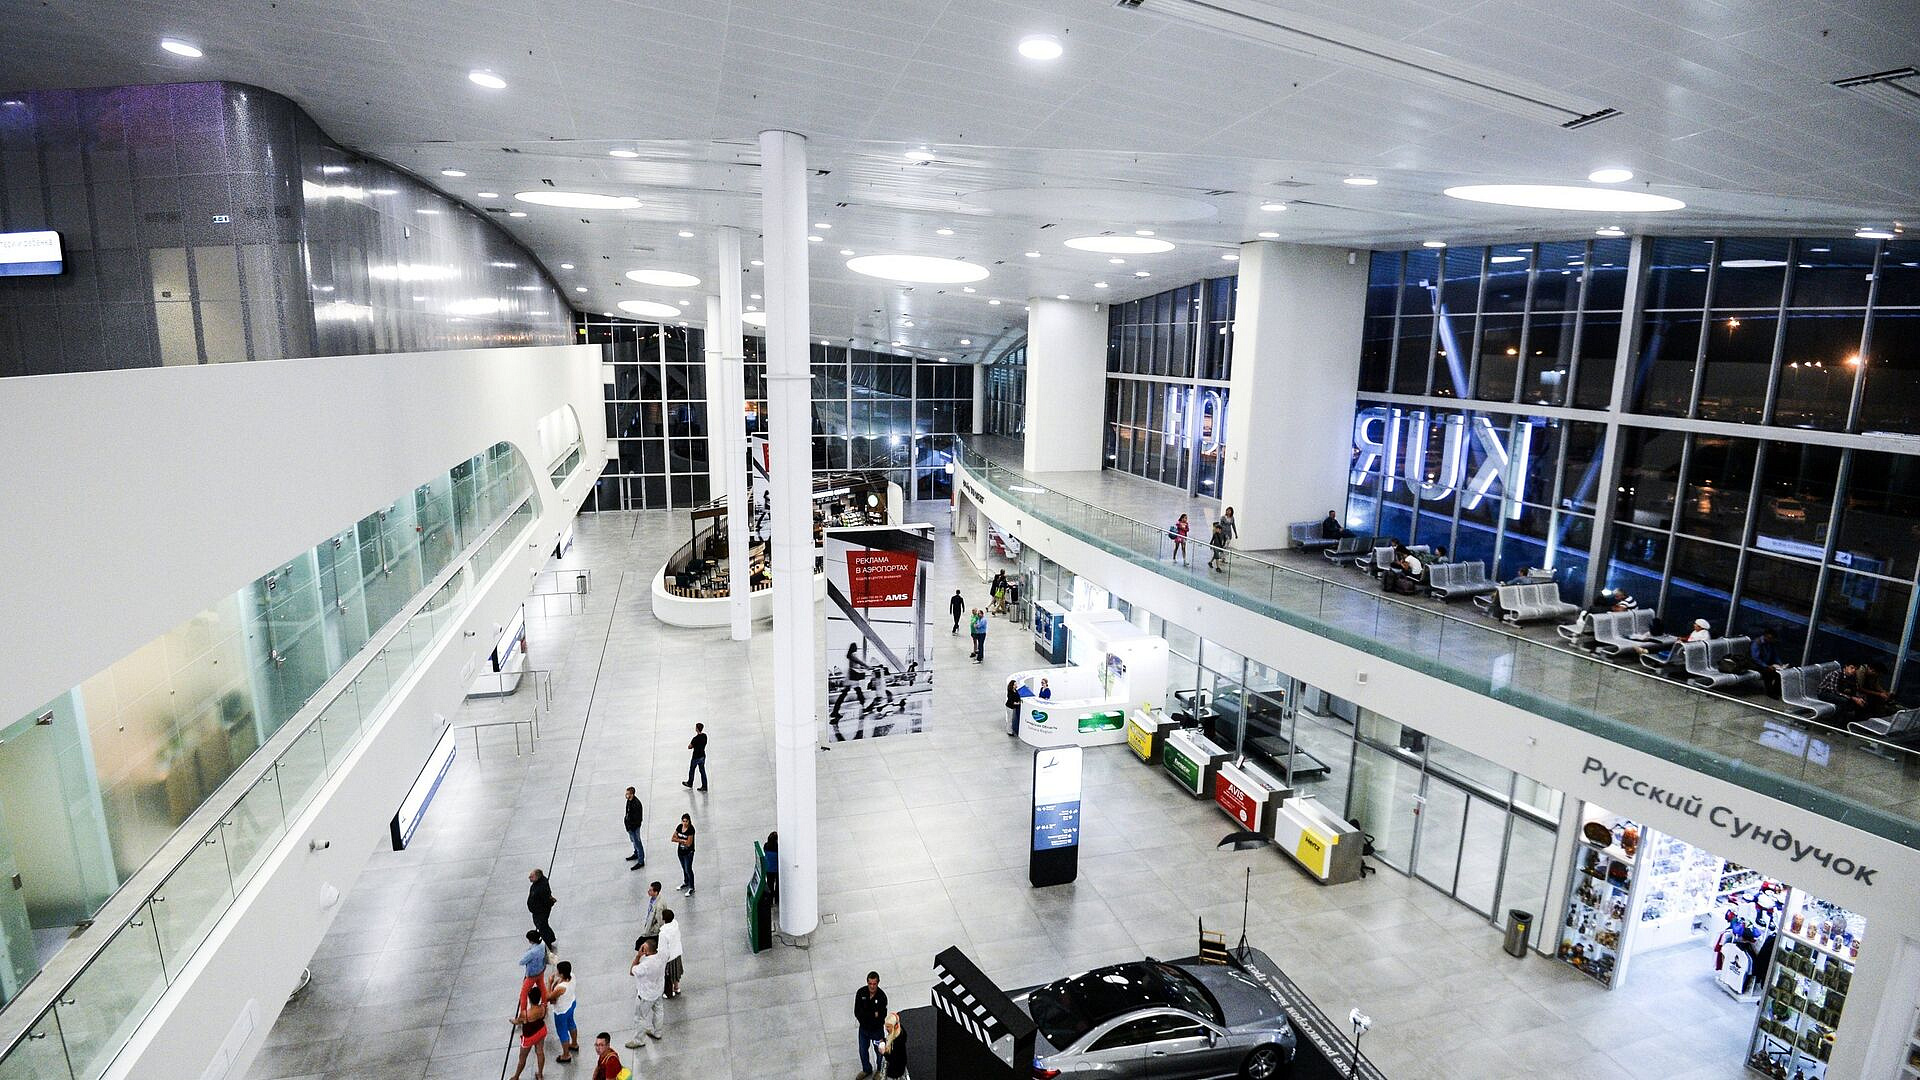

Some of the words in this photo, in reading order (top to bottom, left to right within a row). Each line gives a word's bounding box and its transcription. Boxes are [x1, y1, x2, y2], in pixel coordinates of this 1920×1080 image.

[855, 556, 889, 565] РЕКЛАМА
[862, 564, 909, 574] АЭРОПОРТАХ
[885, 593, 909, 601] AMS
[1228, 783, 1246, 801] AVIS
[1582, 756, 1703, 818] Русский
[1709, 805, 1879, 887] Сундучок
[1304, 836, 1321, 852] Hertz
